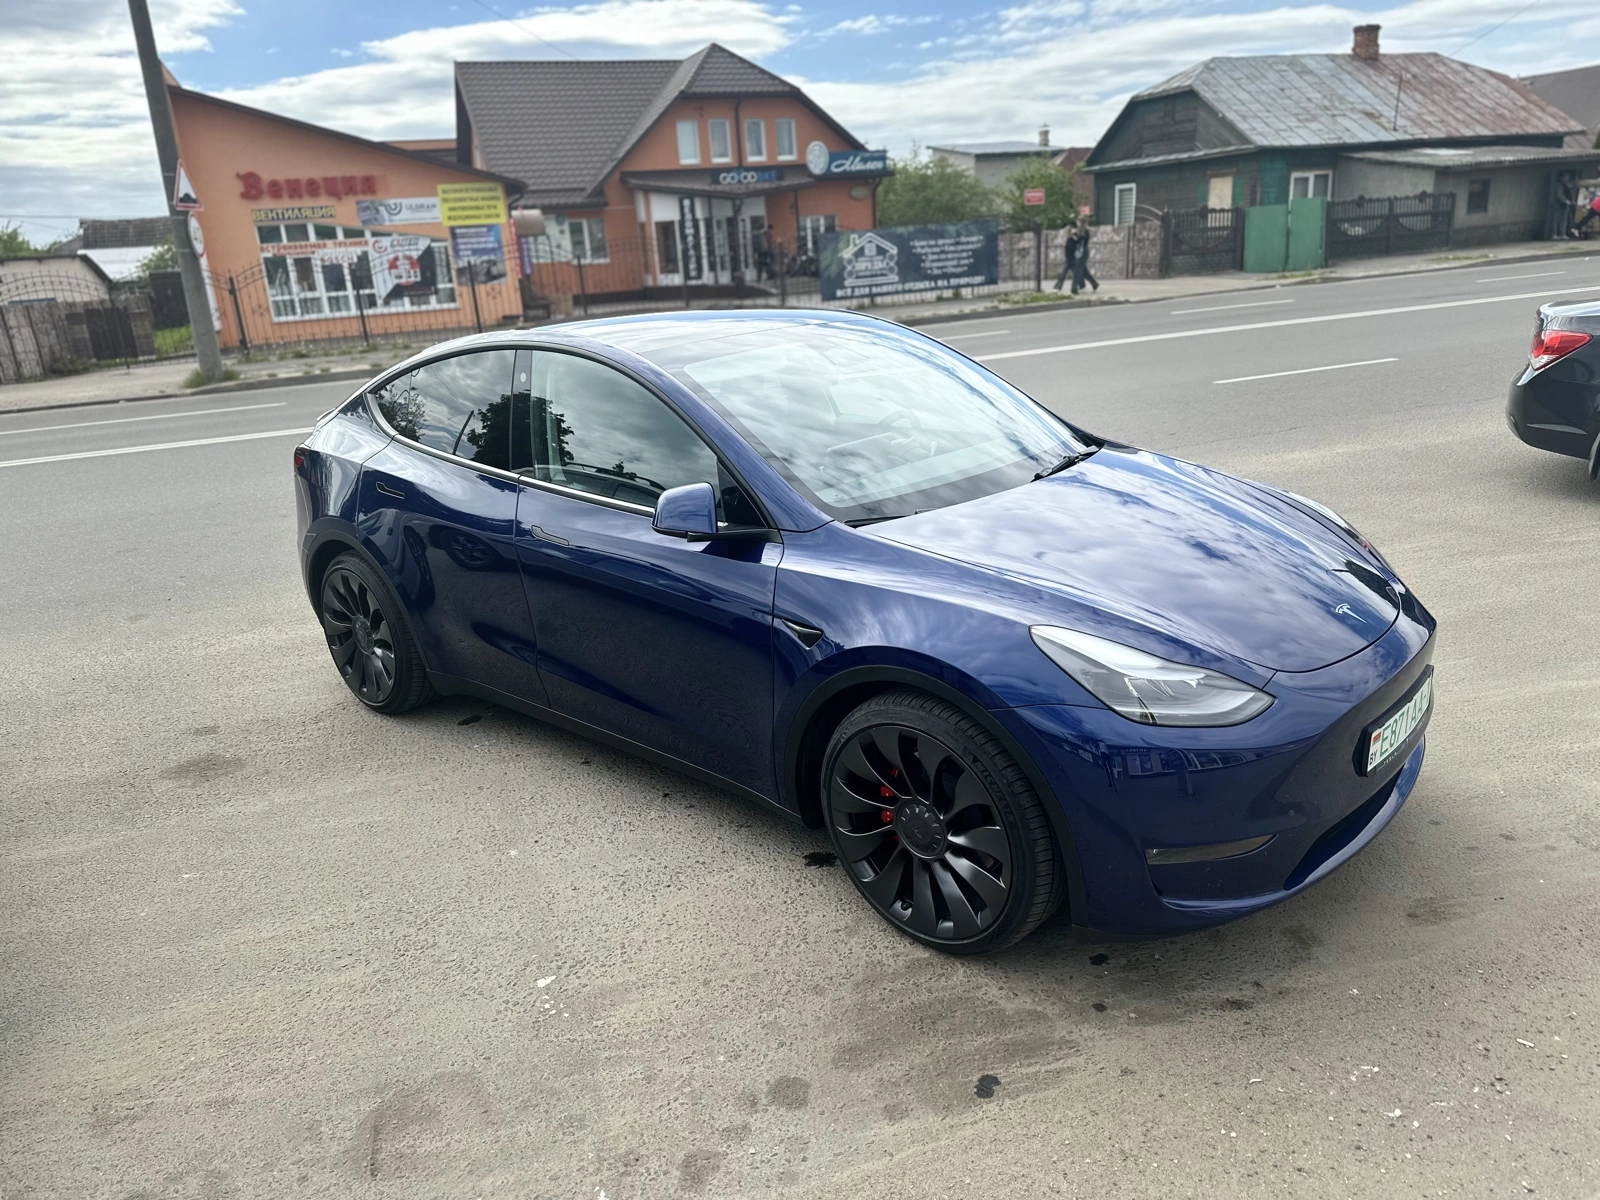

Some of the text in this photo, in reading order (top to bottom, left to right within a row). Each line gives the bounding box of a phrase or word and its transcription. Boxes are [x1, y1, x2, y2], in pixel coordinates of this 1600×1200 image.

[236, 171, 377, 201] Венеция
[252, 206, 335, 221] ВЕНТИЛЯЦИЯ
[1369, 749, 1378, 766] BY
